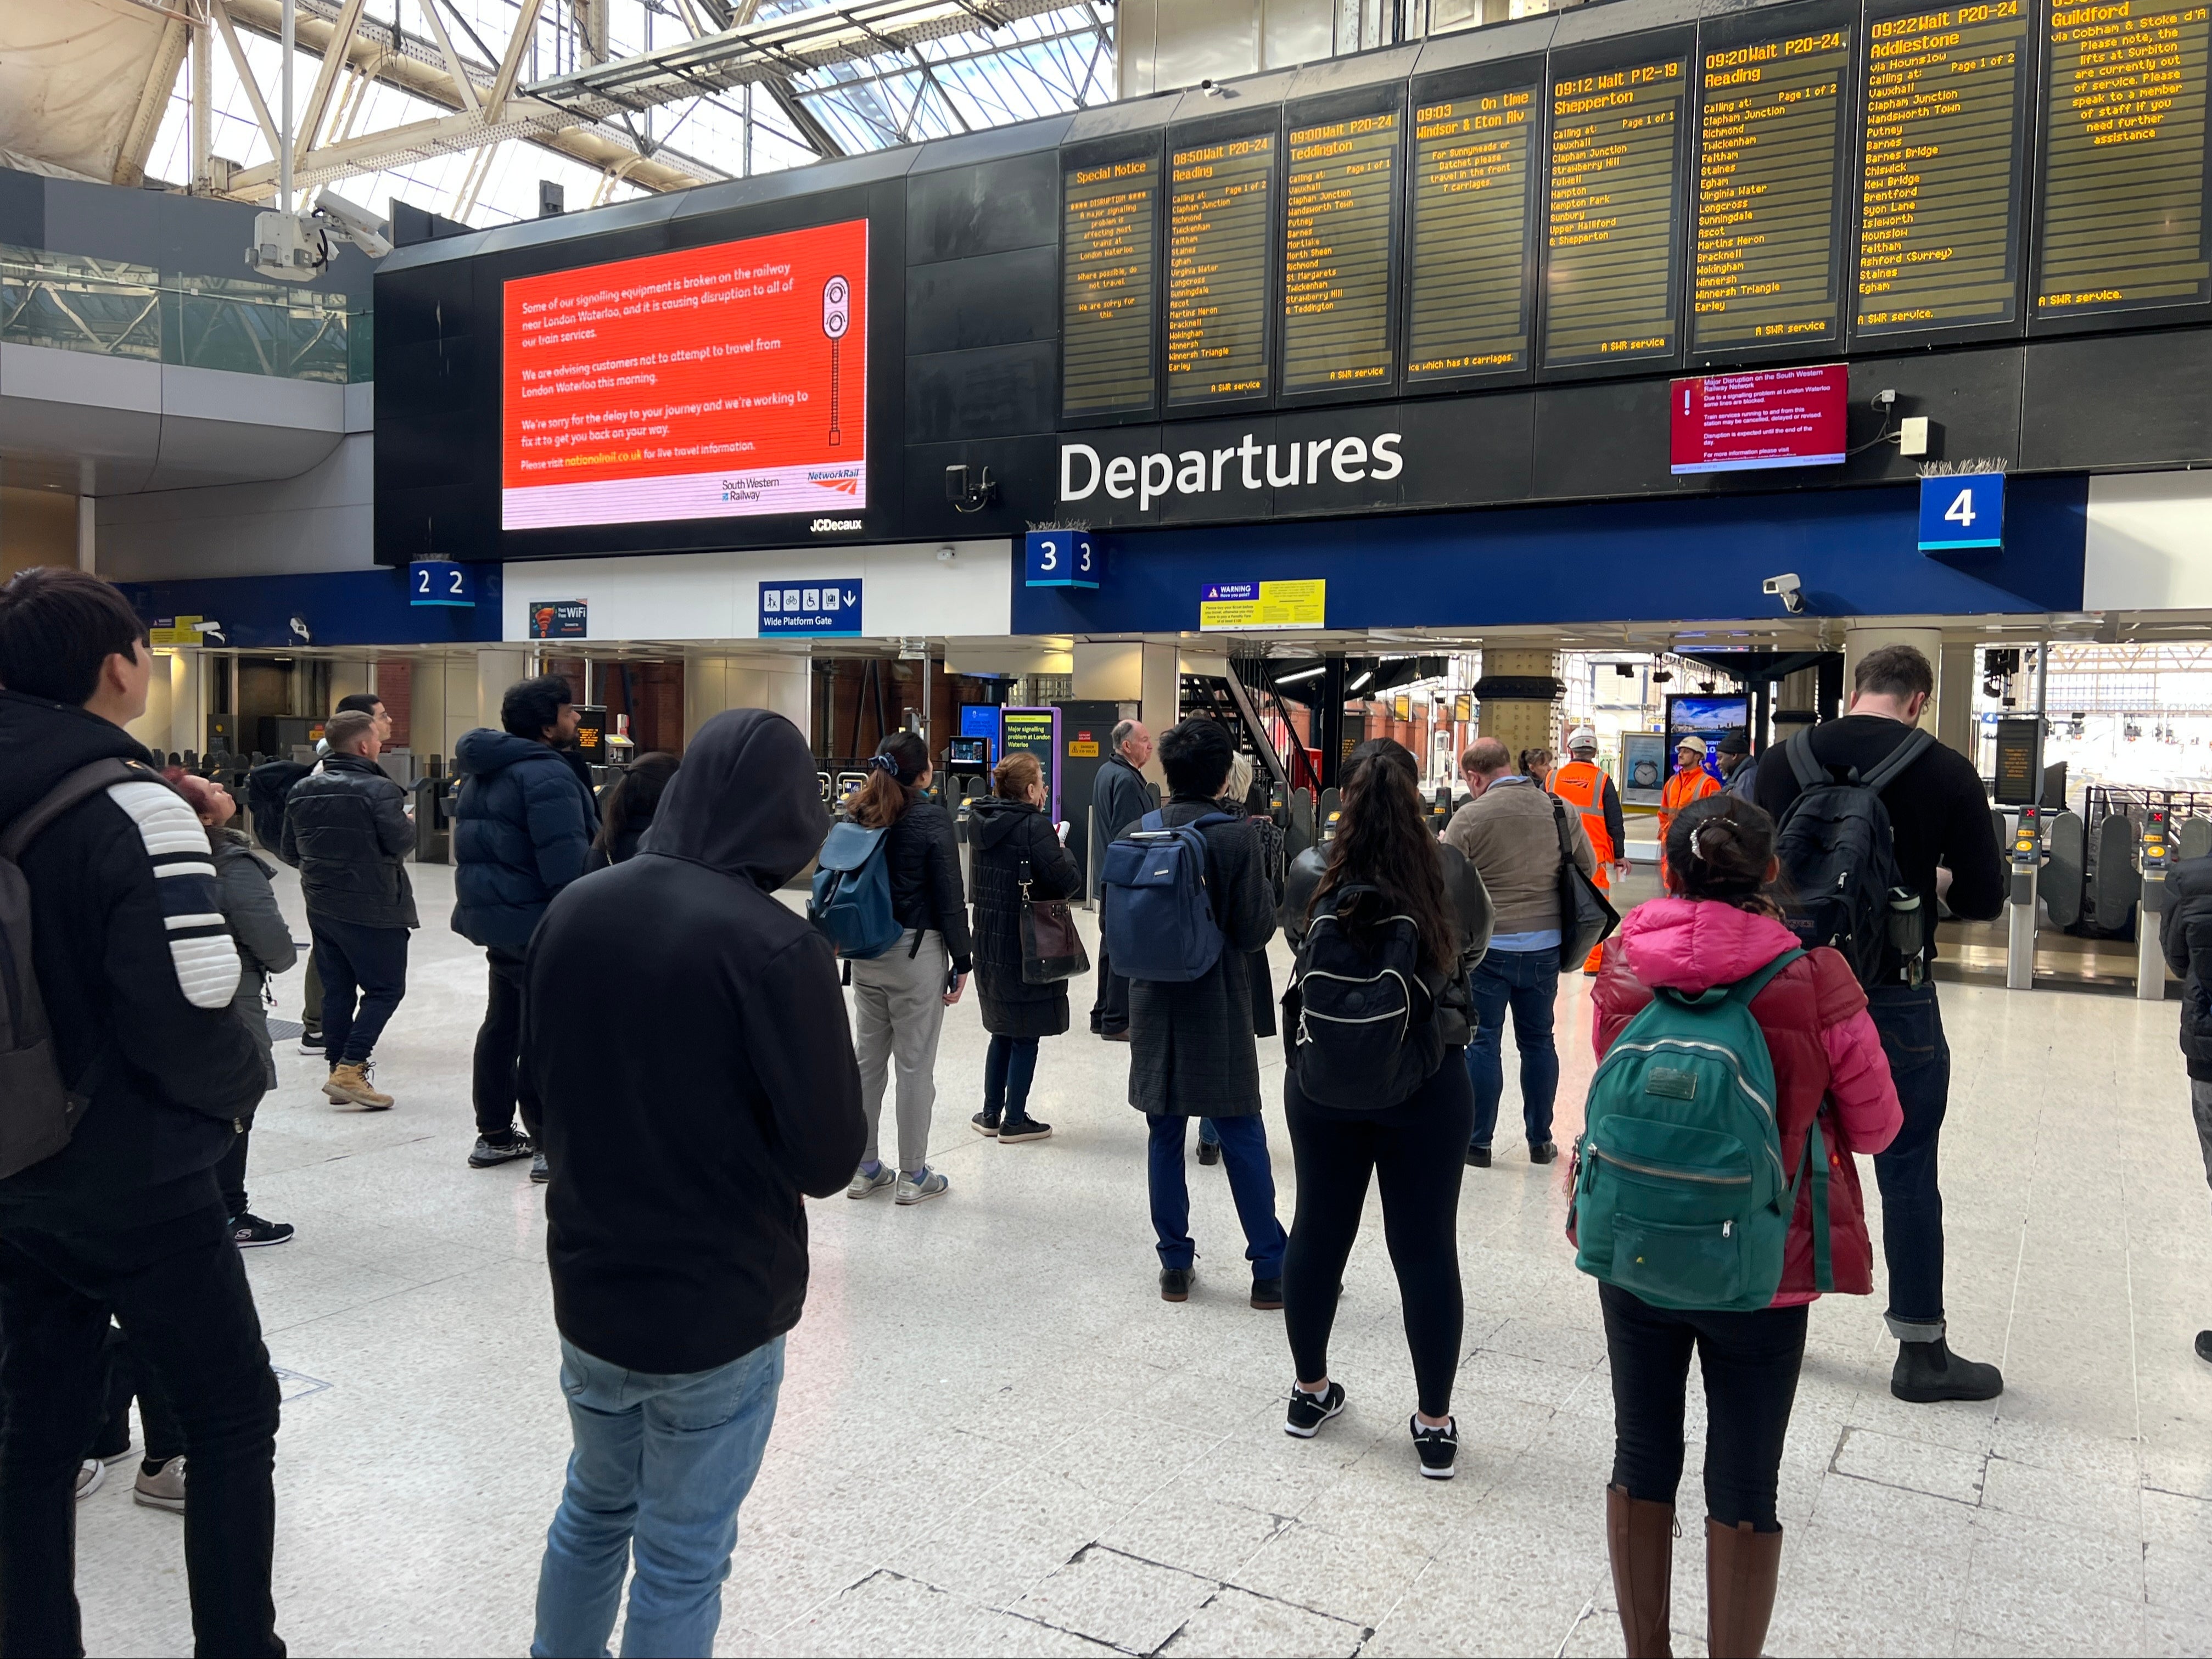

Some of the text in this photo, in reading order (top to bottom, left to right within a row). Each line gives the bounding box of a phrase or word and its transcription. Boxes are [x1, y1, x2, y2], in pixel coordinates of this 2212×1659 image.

[1958, 1, 2017, 23] P20-24
[2052, 2, 2129, 27] Guildford
[2052, 32, 2068, 42] via
[2073, 25, 2119, 39] Cobham
[2125, 20, 2133, 30] &
[2140, 15, 2177, 28] Stoke
[1785, 33, 1839, 55] P20-24
[1871, 33, 1959, 58] Addlestone
[2081, 28, 2179, 51] Please note, the
[2080, 43, 2177, 65] lifts at Surbiton
[2075, 55, 2181, 79] are currently out
[1555, 63, 1677, 97] 09:12 Wait P12-19
[1705, 69, 1761, 87] Reading
[2074, 71, 2180, 93] of service. Please
[1869, 82, 1914, 98] Vauxhall
[2073, 85, 2182, 108] speak to a member
[1417, 93, 1529, 122] 09:03 On time
[1555, 92, 1633, 115] Shepperton
[1868, 91, 1958, 111] Clapham Junction
[2081, 99, 2171, 119] of staff if you
[1868, 104, 1961, 124] Wandsworth Town
[2087, 114, 2164, 132] need further
[1351, 115, 1392, 133] P20-24
[1416, 110, 1525, 138] Windsor & Eton Riv
[1703, 124, 1744, 138] Richmond
[1867, 126, 1902, 138] Putney
[1703, 137, 1756, 151] Twickenham
[1867, 138, 1902, 151] Barnes
[2094, 129, 2155, 144] assistance
[1229, 138, 1268, 155] P20-24
[1291, 142, 1353, 160] Teddington
[1702, 152, 1738, 163] Feltham
[1077, 163, 1146, 183] Special Notice
[1173, 166, 1213, 181] Reading
[1701, 164, 1736, 176] Staines
[1865, 162, 1906, 176] Chiswick
[1701, 178, 1729, 190] Egham
[1864, 187, 1917, 203] Brentford
[1700, 200, 1748, 213] Longcross
[1699, 226, 1725, 238] Ascot
[1698, 249, 1741, 262] Bracknell
[1696, 262, 1744, 275] Wokingham
[522, 264, 791, 314] Some of our signalling equipment is broken on the railway
[1696, 274, 1737, 287] Winnersh
[522, 278, 794, 330] near London Waterloo, and it is causing disruption to all of
[522, 329, 597, 348] our train services.
[522, 338, 781, 380] We are advising customers not to attempt to travel from
[522, 374, 658, 398] London Waterloo this morning.
[521, 439, 755, 470] Please visit nationalrail.co.uk for live travel information.
[1061, 433, 1403, 511] Departures
[723, 478, 779, 490] South Western
[730, 491, 760, 501] Railway
[1944, 489, 1976, 527] 4
[810, 518, 863, 533] JCDecaux
[1040, 541, 1057, 571] 3
[1080, 542, 1091, 572] 3
[418, 570, 430, 593] 2
[449, 570, 463, 593] 2
[1220, 585, 1251, 593] WARNING
[567, 607, 586, 618] WiFi
[764, 615, 832, 626] Wide Platform Gate
